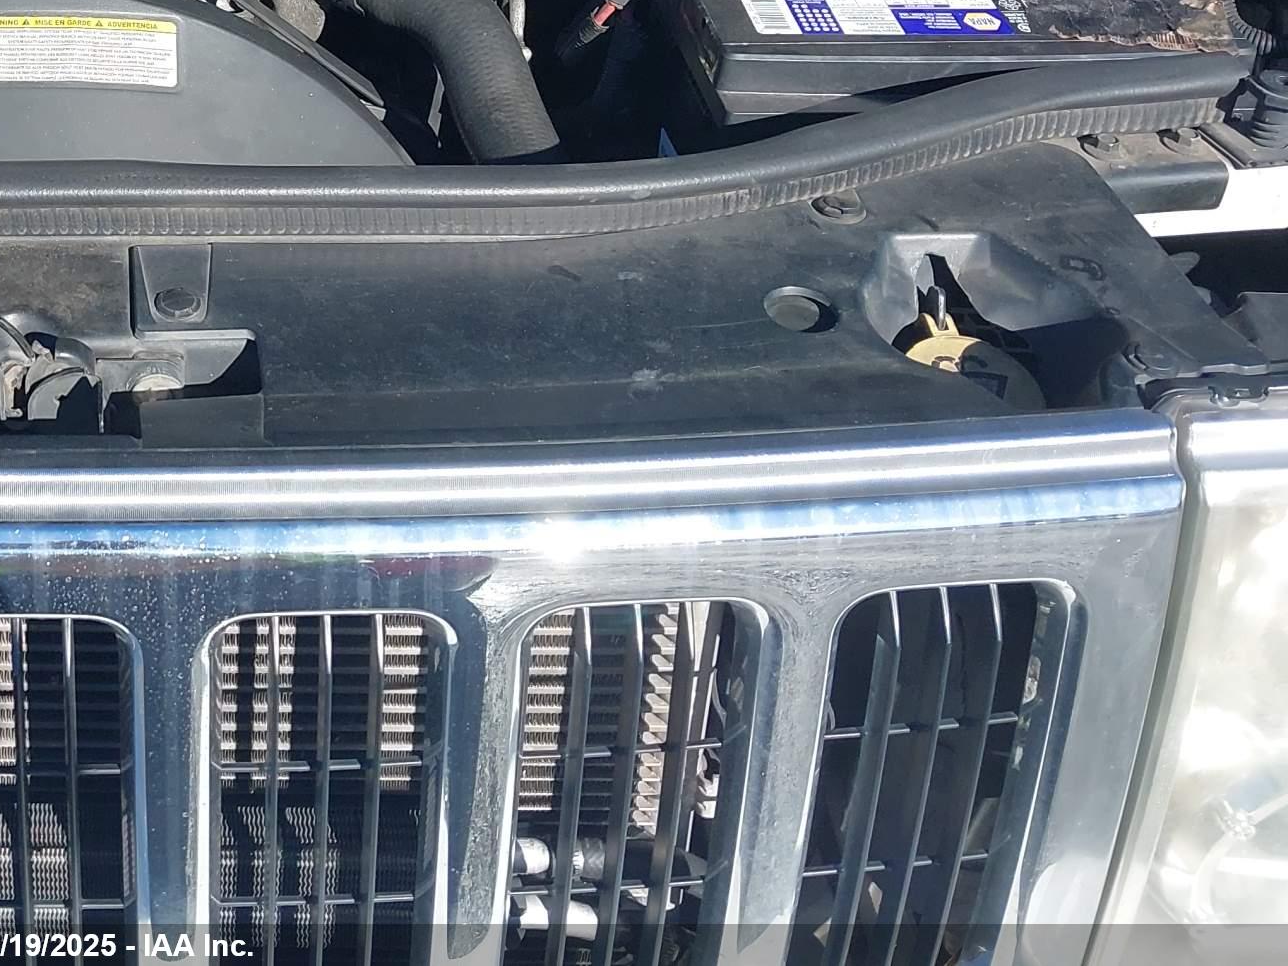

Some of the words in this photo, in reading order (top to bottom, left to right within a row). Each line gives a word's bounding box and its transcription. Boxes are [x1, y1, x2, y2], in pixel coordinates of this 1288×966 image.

[66, 19, 92, 27] GARDE
[107, 21, 158, 30] ADVERTENCIA
[967, 17, 996, 26] NAPA
